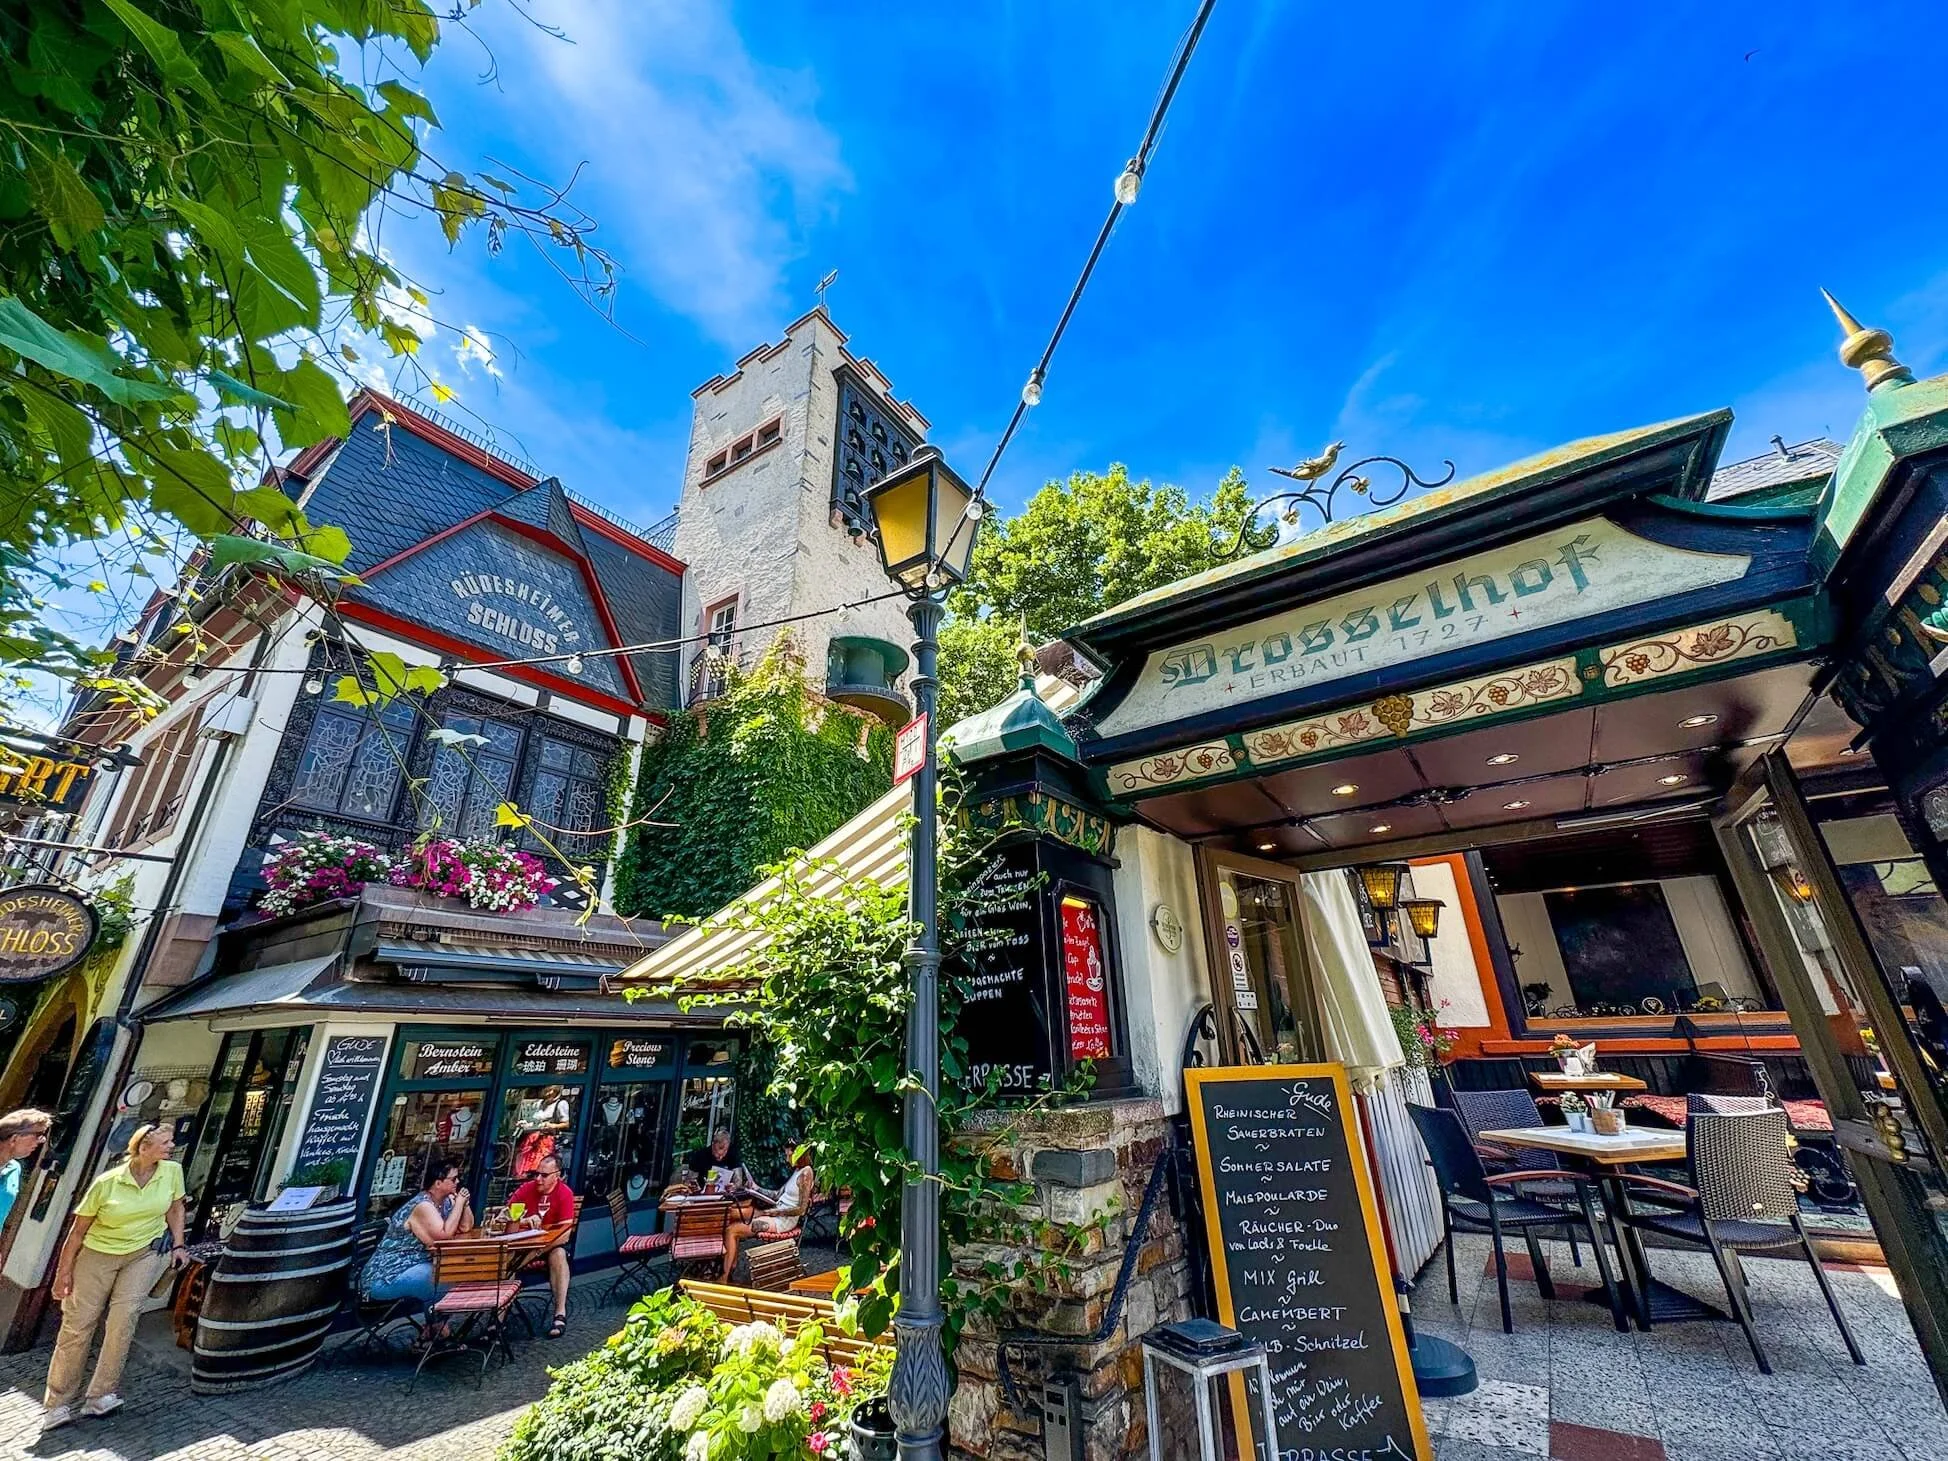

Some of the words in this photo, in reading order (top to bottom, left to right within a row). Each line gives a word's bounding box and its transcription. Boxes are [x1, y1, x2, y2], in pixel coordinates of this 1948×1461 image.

[451, 571, 580, 643] RÜDESHEIMER
[1158, 534, 1601, 698] Drosselhof
[467, 600, 559, 655] SCHLOSS
[1249, 645, 1370, 689] ERBAUT
[1399, 614, 1489, 651] 1727
[993, 868, 1013, 880] auch
[1014, 869, 1028, 878] nur
[418, 1043, 483, 1058] Bernstein
[525, 1043, 580, 1057] Edelsteine
[622, 1040, 662, 1053] Precious
[626, 1053, 656, 1065] Stones
[424, 1060, 471, 1075] Amber
[1289, 1082, 1332, 1113] Gude
[1213, 1105, 1297, 1119] RHEINISCHER
[1227, 1125, 1325, 1140] SAUERBRATEN
[1225, 1189, 1328, 1206] MAISPOULARDE
[1229, 1242, 1246, 1252] von
[1244, 1270, 1275, 1285] MIX
[1286, 1270, 1326, 1295] Grill
[1240, 1306, 1347, 1322] CAMEMBERT
